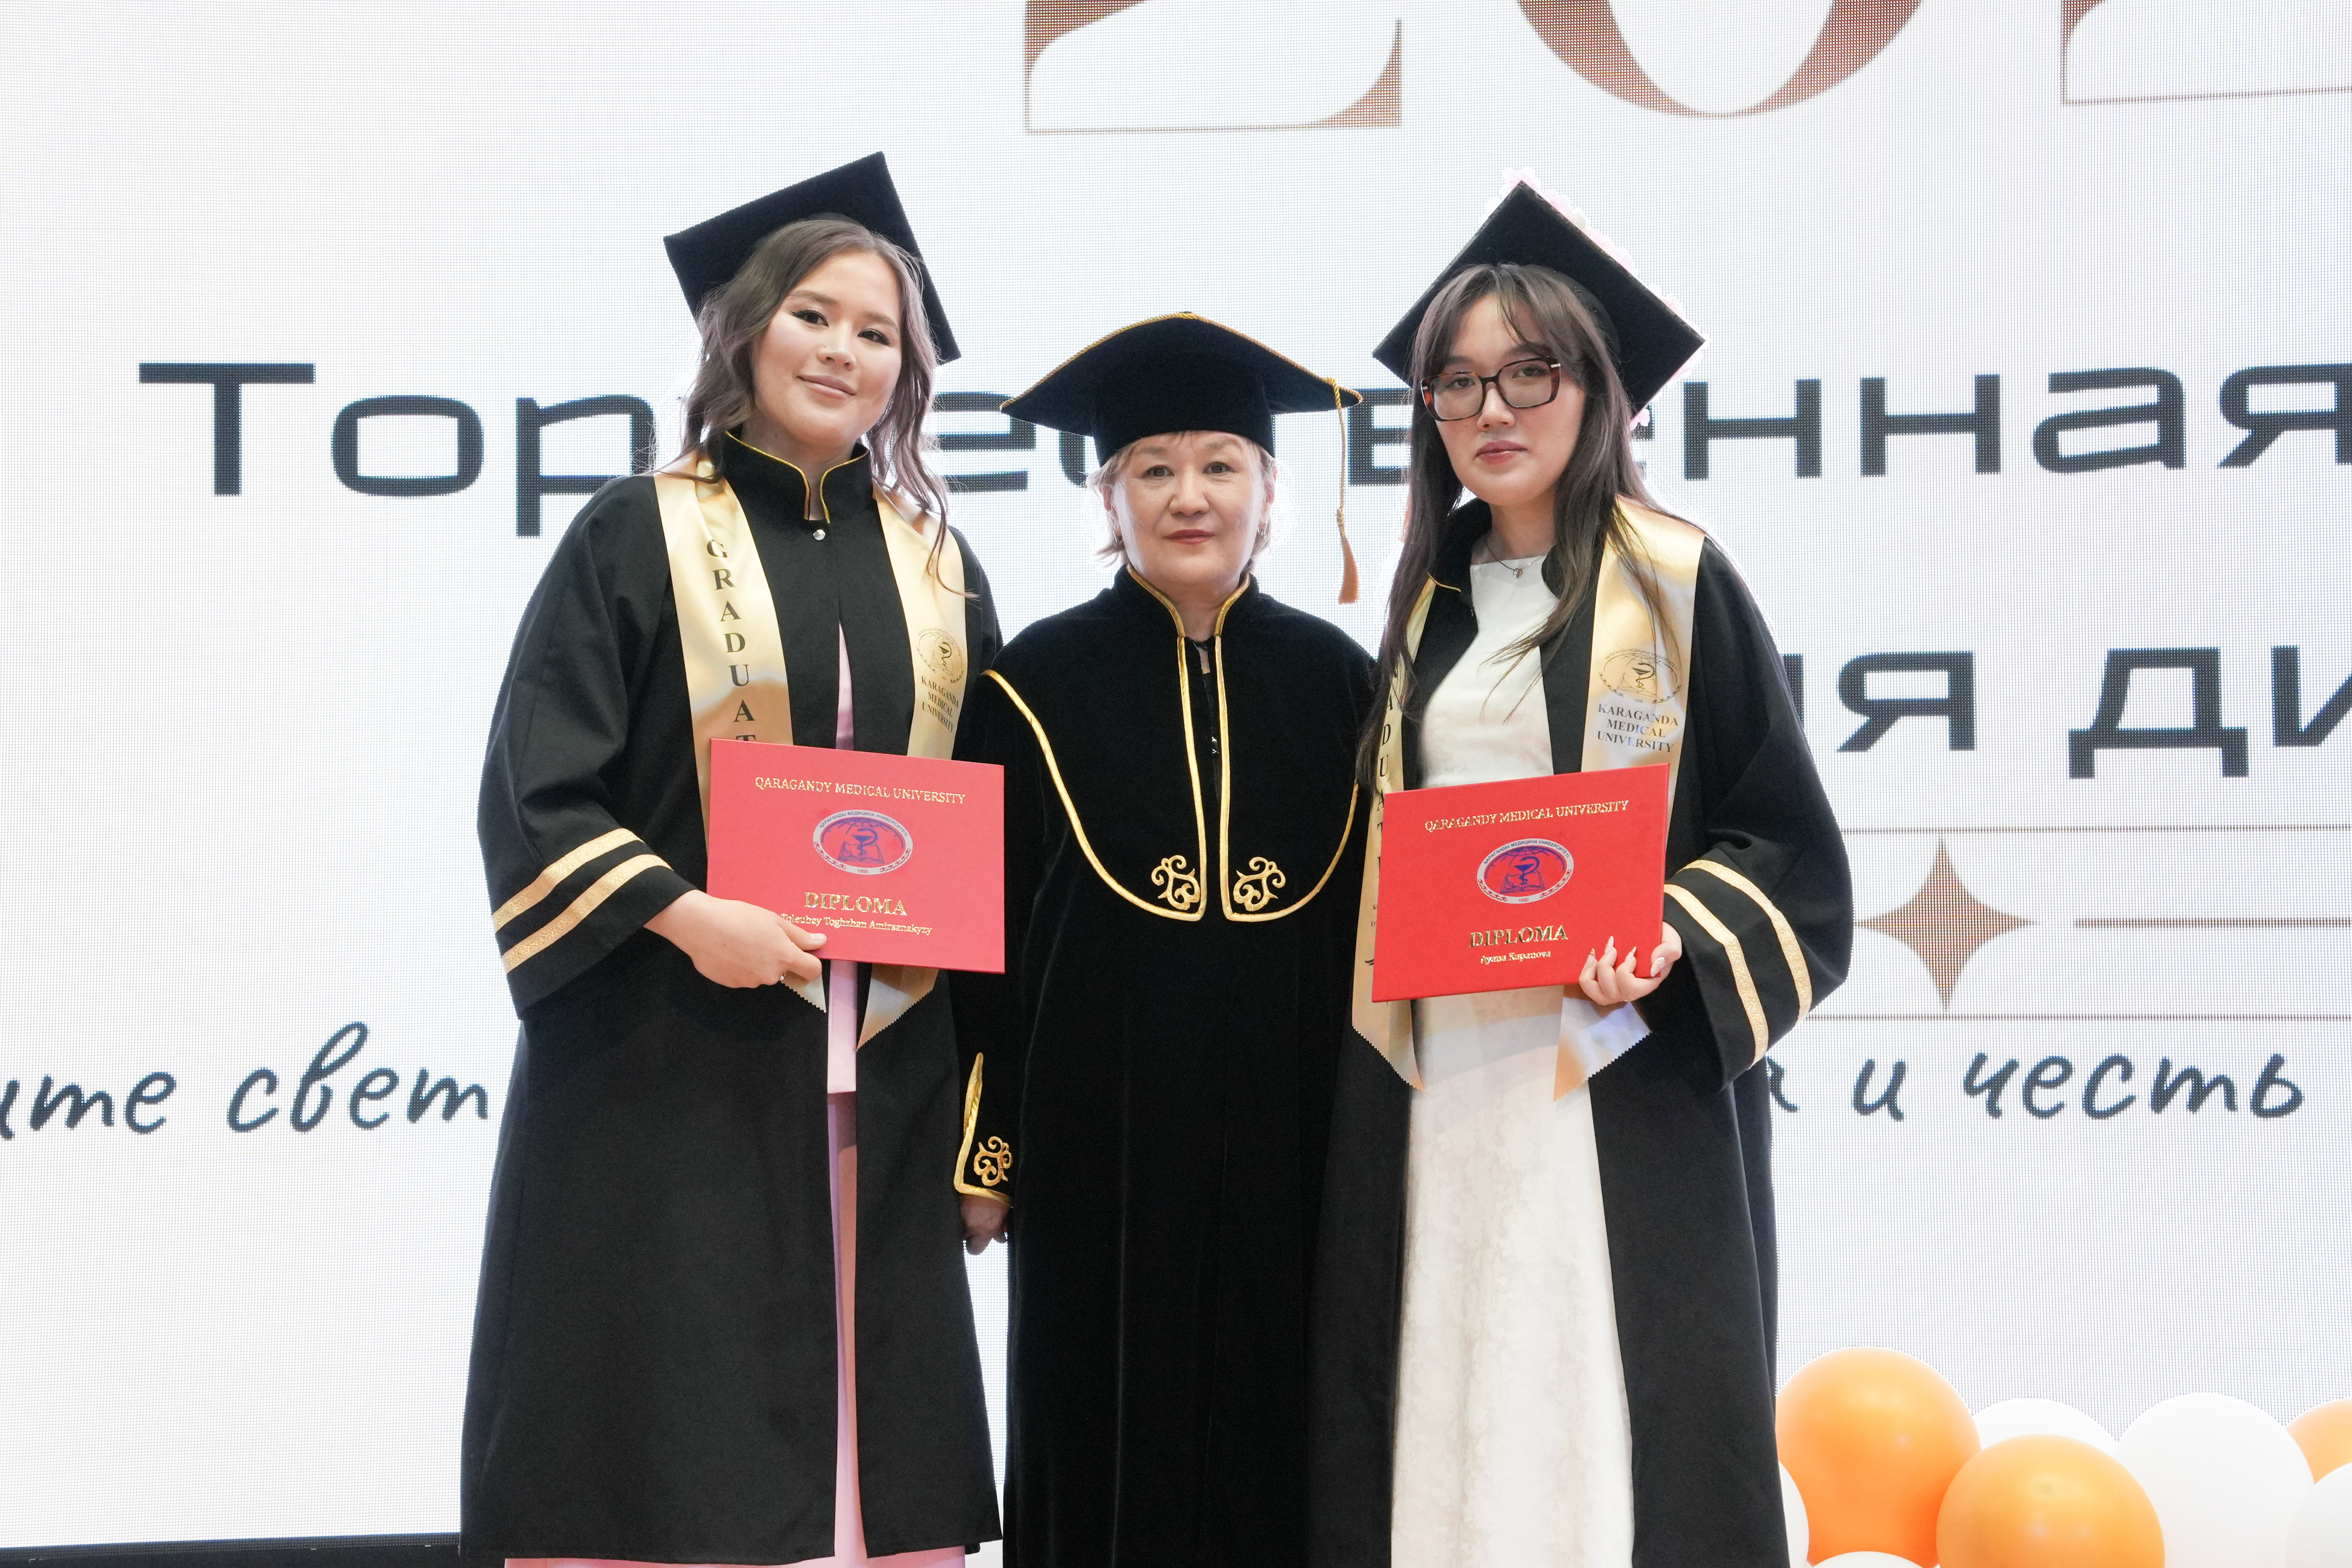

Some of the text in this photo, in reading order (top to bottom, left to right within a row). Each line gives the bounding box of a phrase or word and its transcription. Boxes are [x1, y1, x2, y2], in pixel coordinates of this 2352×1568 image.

[921, 675, 959, 709] KARAGANDA
[922, 701, 953, 733] UNIVERSITY
[928, 692, 953, 718] MEDICAL
[1598, 703, 1679, 726] KARAGANDA
[1607, 719, 1666, 738] MEDICAL
[1598, 731, 1674, 752] UNIVERSITY
[754, 776, 966, 805] QARAGANDY MEDICAL UNIVERSITY
[1424, 800, 1630, 833] QARAGANDY MEDICAL UNIVERSITY
[804, 892, 908, 916] DIPLOMA
[780, 914, 932, 935] Toleubay Toghzhan Amirsanakyzy
[1469, 925, 1569, 947] DIPLOMA
[1480, 950, 1551, 965] Ayana Kapanova
[227, 1020, 488, 1133] свет
[1852, 1058, 1908, 1122] и
[1963, 1051, 2305, 1121] честь
